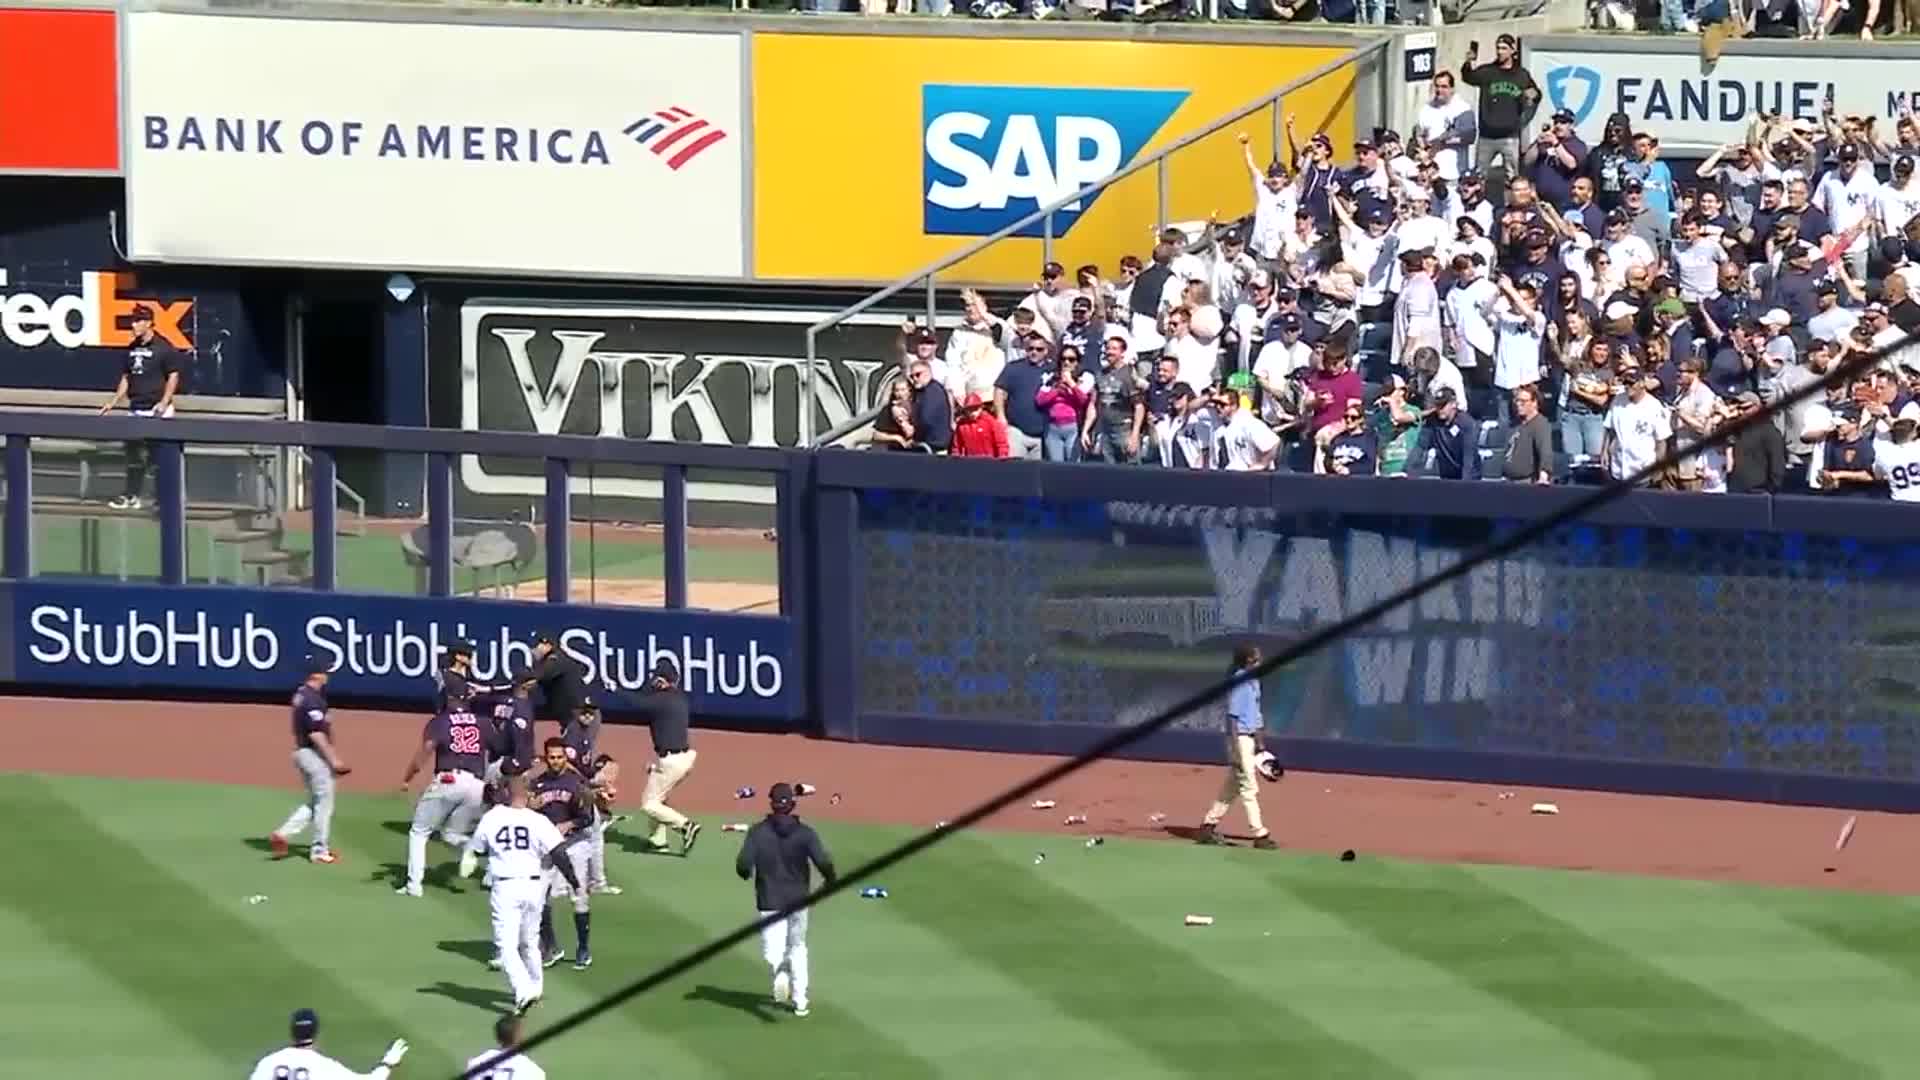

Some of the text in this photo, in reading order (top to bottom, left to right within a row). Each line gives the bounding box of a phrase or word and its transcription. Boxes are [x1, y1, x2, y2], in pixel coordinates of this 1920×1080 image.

[1412, 53, 1431, 73] 103
[145, 116, 610, 165] BANK OF AMERICA
[926, 111, 1122, 211] SAP
[0, 268, 195, 349] edEx
[29, 605, 279, 670] StubHub
[559, 628, 782, 697] StubHub
[1352, 638, 1494, 704] WIN
[449, 725, 480, 753] 32
[495, 825, 530, 851] 48
